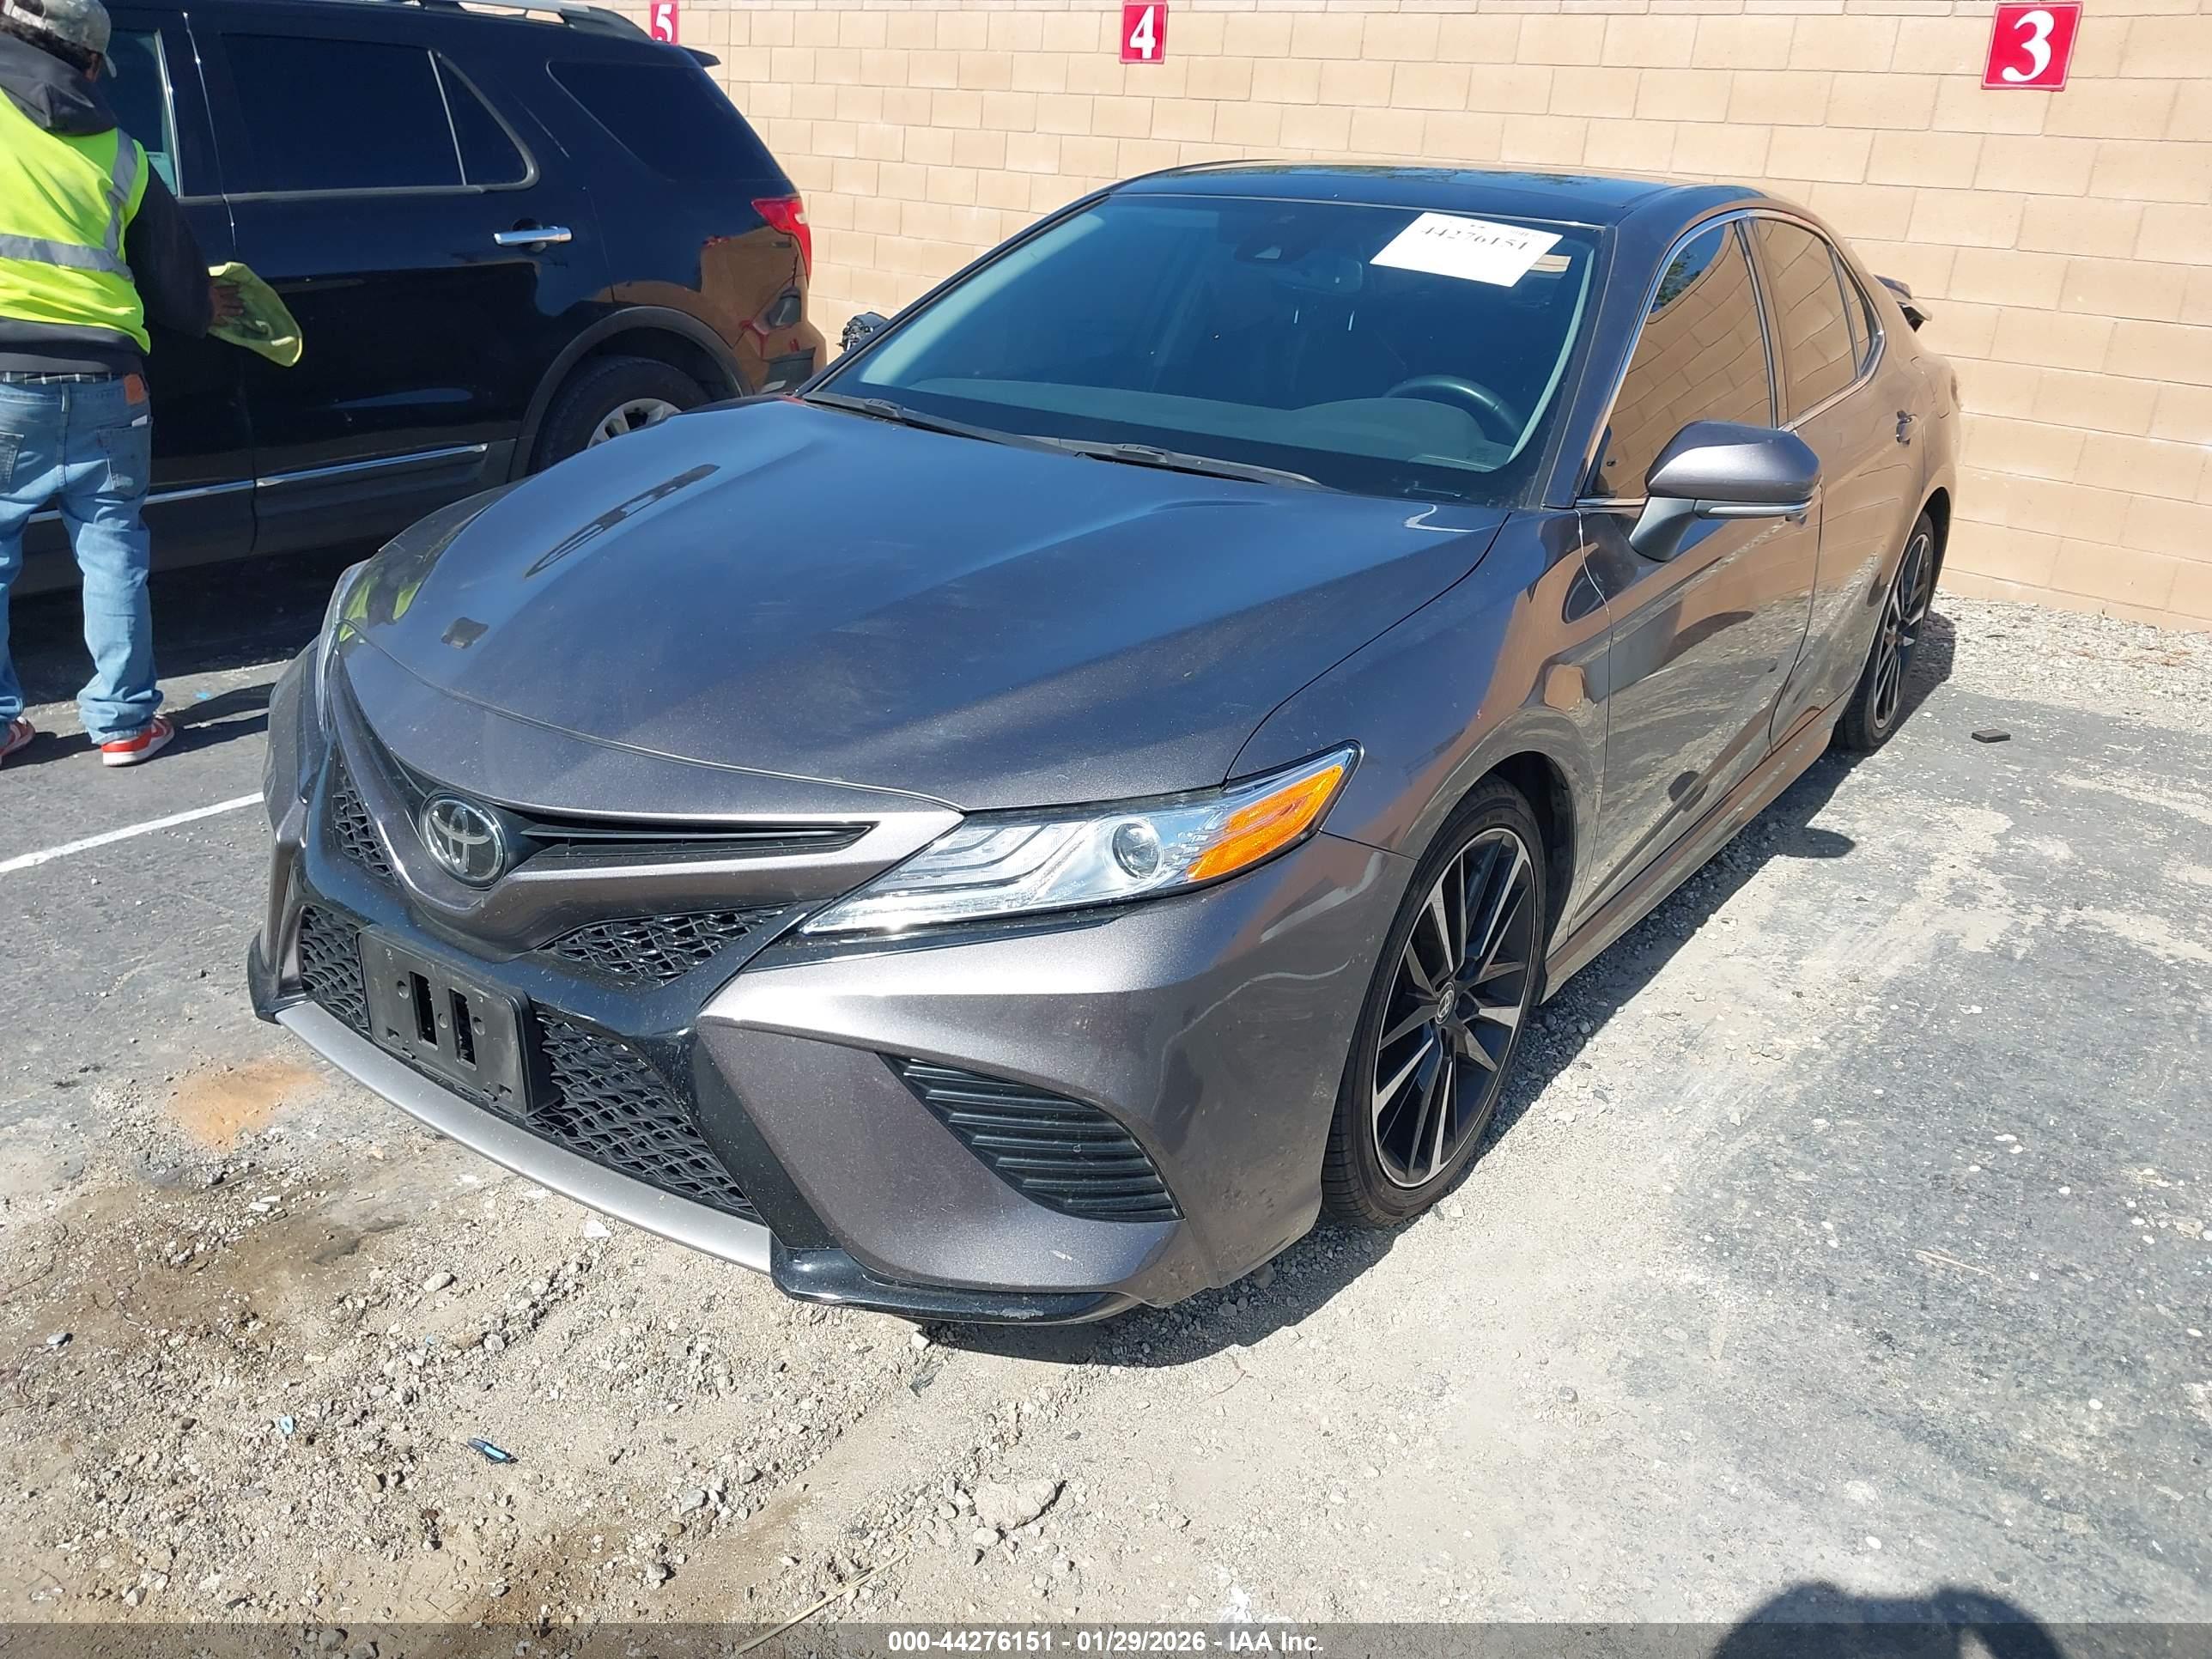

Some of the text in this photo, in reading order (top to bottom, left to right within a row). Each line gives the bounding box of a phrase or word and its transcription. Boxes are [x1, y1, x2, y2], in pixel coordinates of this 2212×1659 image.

[655, 3, 673, 43] 5
[1129, 5, 1157, 59] 4
[2002, 9, 2055, 82] 3
[1420, 227, 1528, 251] 44276151
